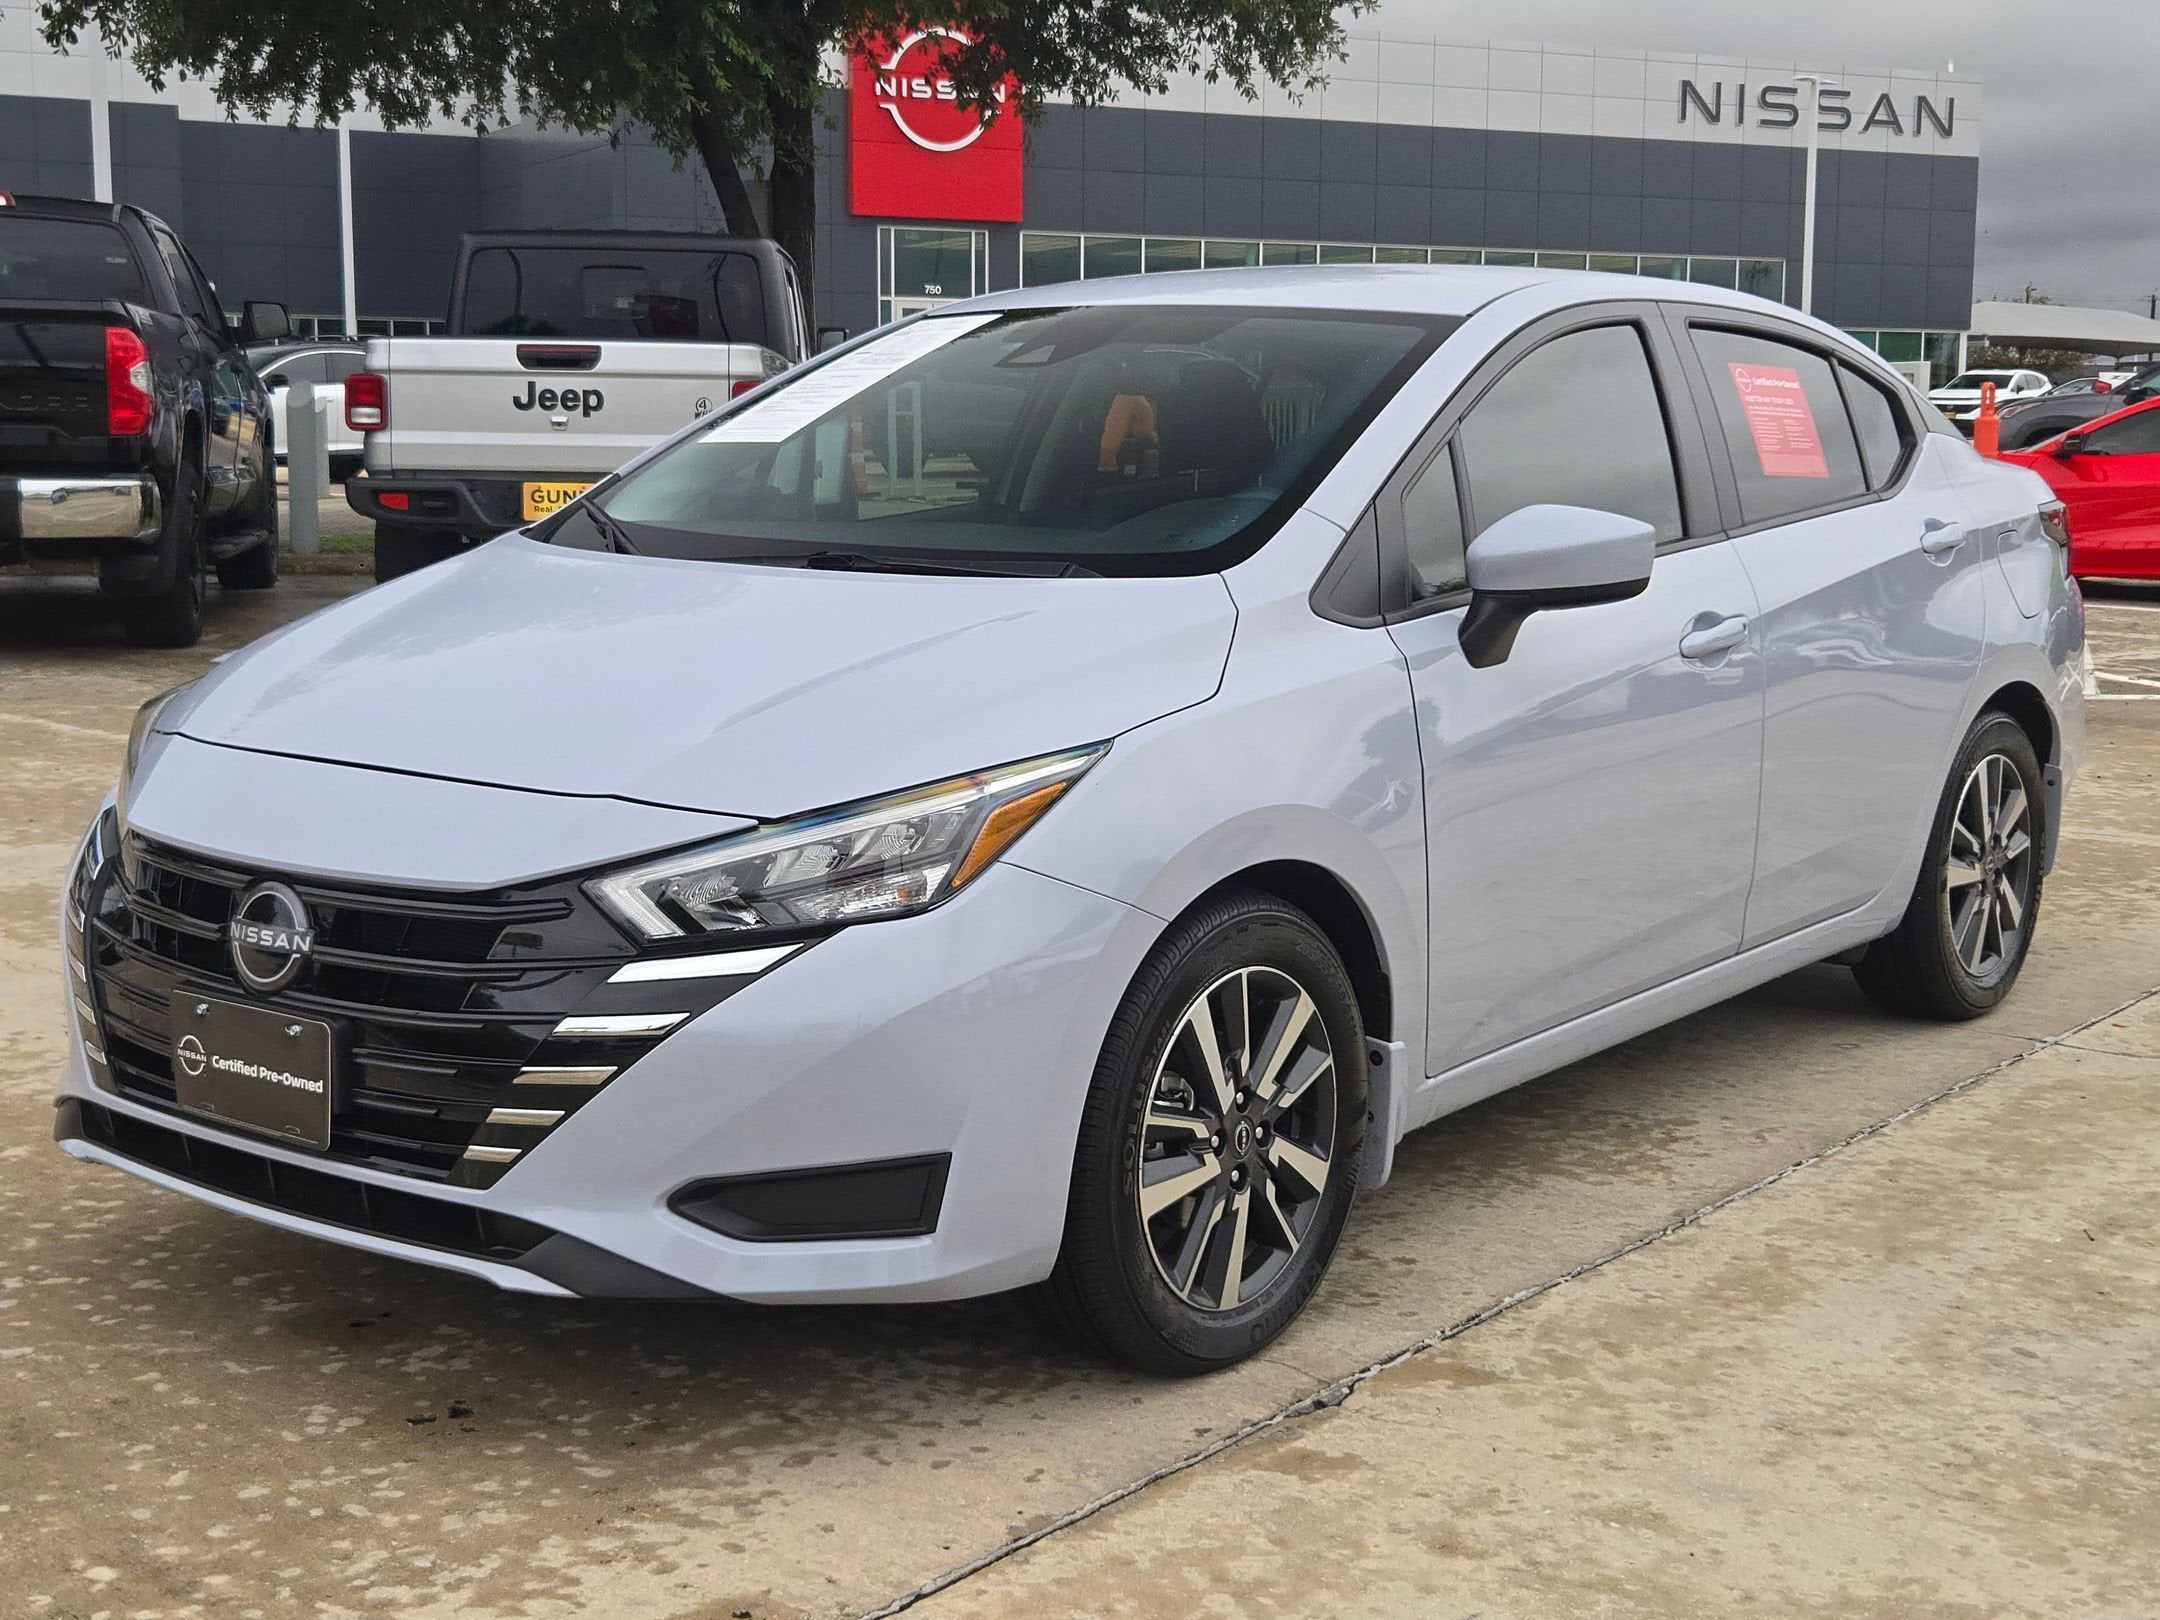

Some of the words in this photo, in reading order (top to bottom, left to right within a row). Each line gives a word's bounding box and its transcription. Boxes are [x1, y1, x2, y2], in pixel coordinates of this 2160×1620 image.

[875, 76, 1006, 103] NISSN
[1678, 78, 1955, 138] NISSAN
[924, 284, 942, 295] 750
[512, 381, 605, 418] Jeep
[530, 489, 585, 504] GUN
[230, 921, 311, 952] NISSAN
[178, 1048, 207, 1062] NISSAN
[211, 1055, 258, 1078] Certified
[259, 1066, 324, 1093] Pre-Owned
